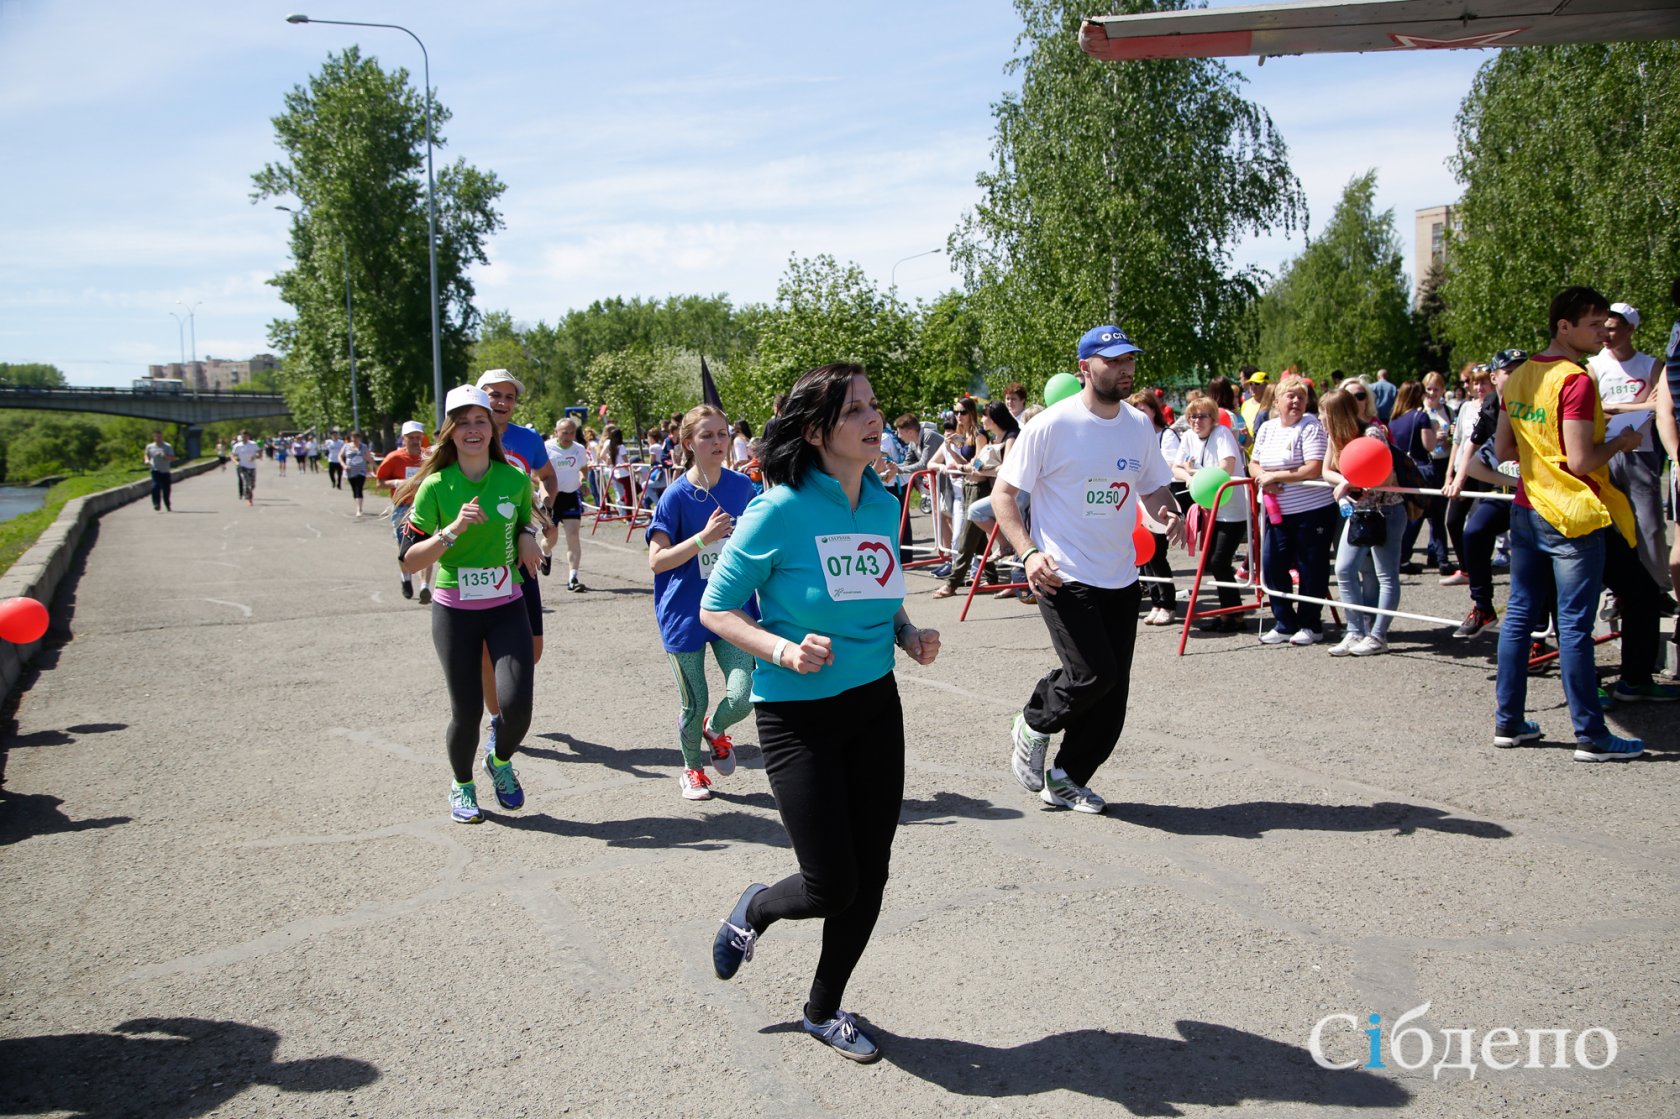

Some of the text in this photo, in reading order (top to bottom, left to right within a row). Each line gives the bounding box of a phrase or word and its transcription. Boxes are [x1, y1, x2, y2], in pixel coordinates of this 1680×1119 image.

[1610, 384, 1637, 395] 1815
[1086, 490, 1119, 504] 0250
[504, 522, 514, 565] RUNNI
[701, 552, 719, 566] 03
[827, 554, 880, 577] 0743
[461, 571, 497, 587] 1351
